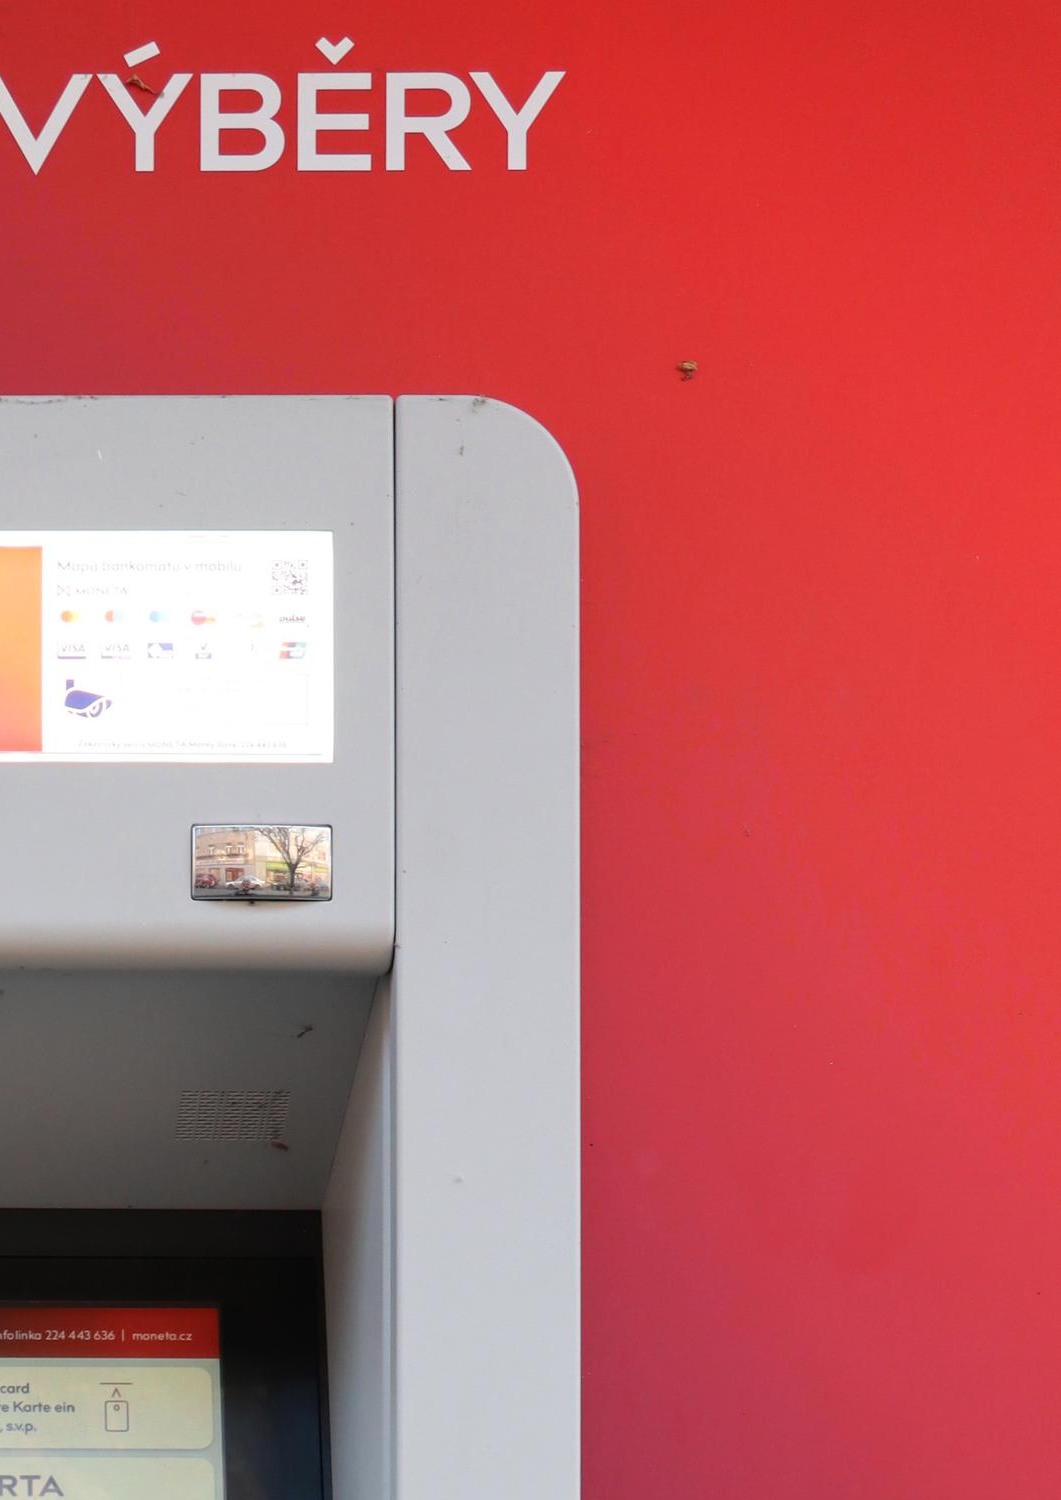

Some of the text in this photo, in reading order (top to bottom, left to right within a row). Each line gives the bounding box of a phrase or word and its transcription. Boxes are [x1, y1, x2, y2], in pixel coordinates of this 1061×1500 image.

[45, 1330, 65, 1341] 224
[68, 1330, 91, 1341] 443
[93, 1330, 115, 1341] 636
[132, 1331, 193, 1342] moneta.cz
[0, 1382, 30, 1394] card
[13, 1401, 50, 1413] Karte
[54, 1402, 75, 1413] ein
[6, 1423, 37, 1435] s.v.p.
